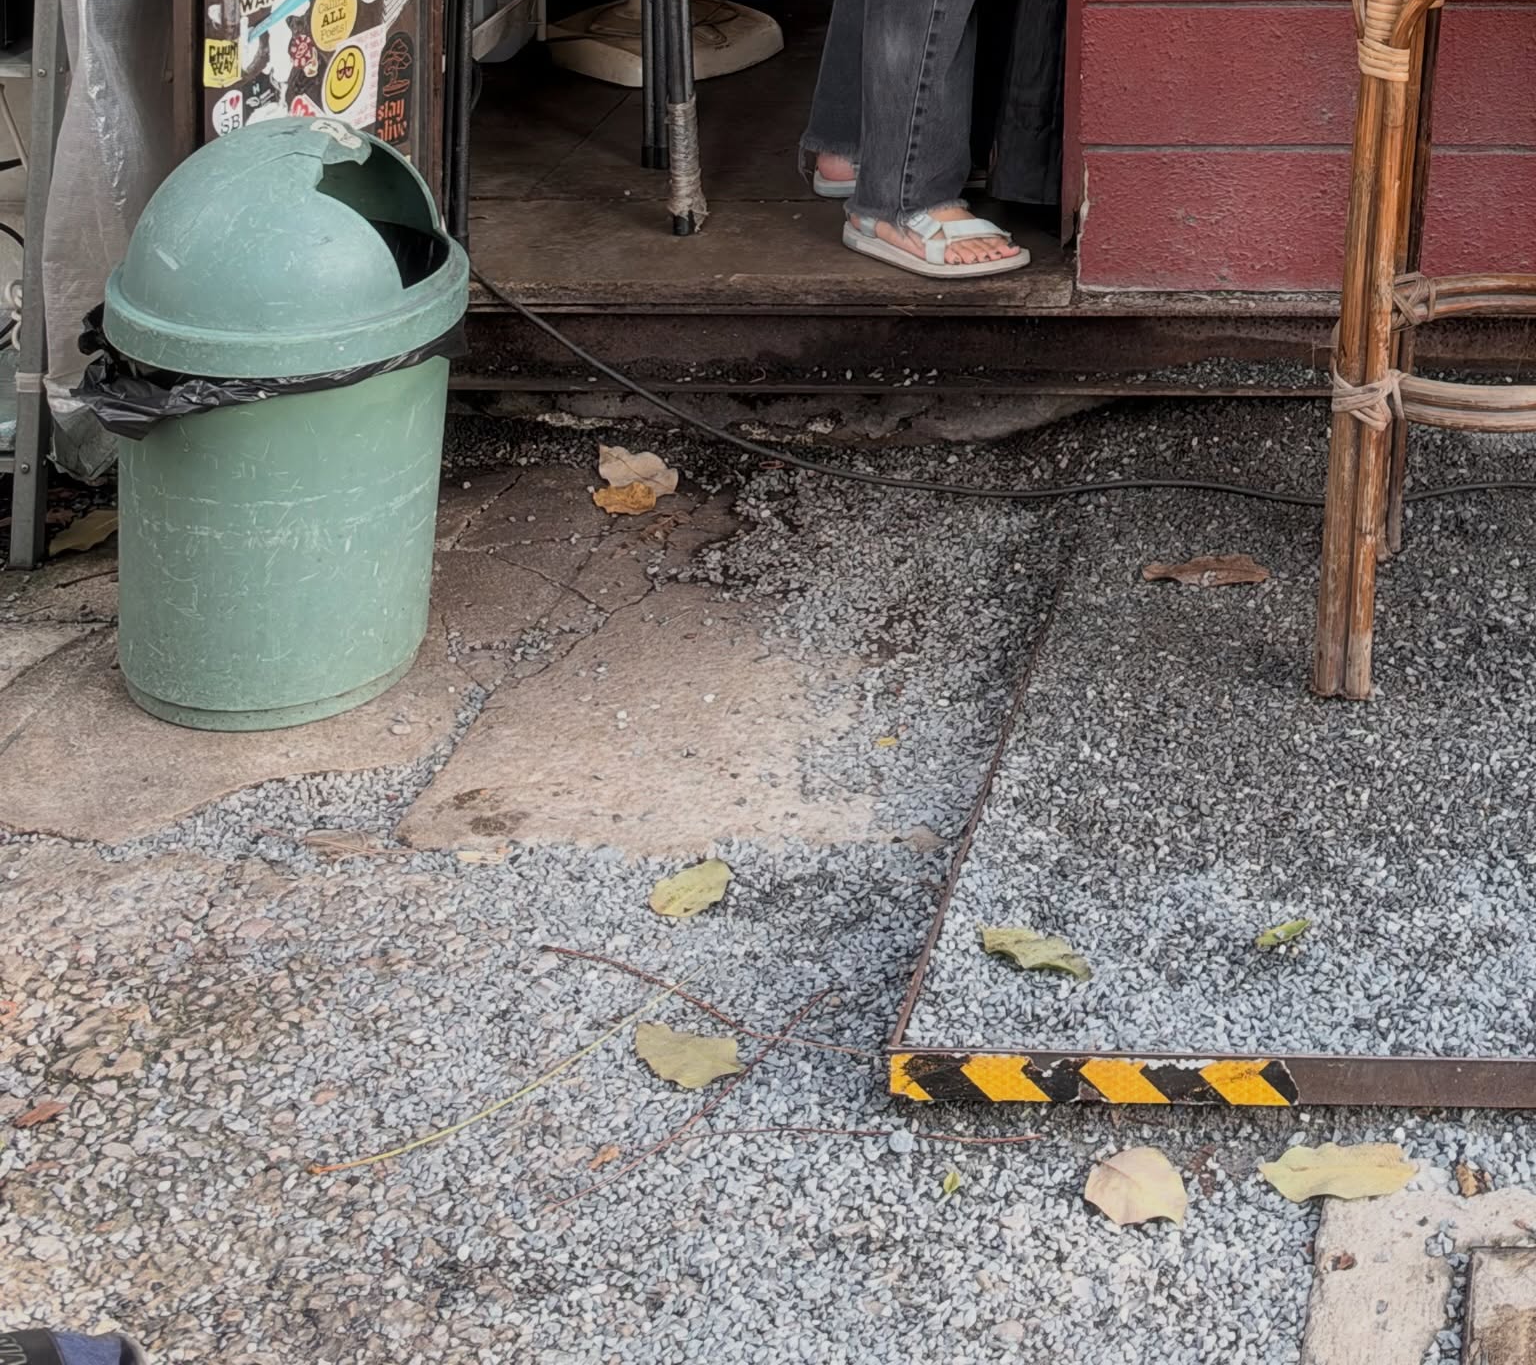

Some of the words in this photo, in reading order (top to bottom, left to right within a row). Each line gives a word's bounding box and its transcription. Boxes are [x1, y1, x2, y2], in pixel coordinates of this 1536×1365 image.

[321, 8, 347, 28] ALL
[377, 99, 405, 120] stay
[378, 119, 408, 142] alive
